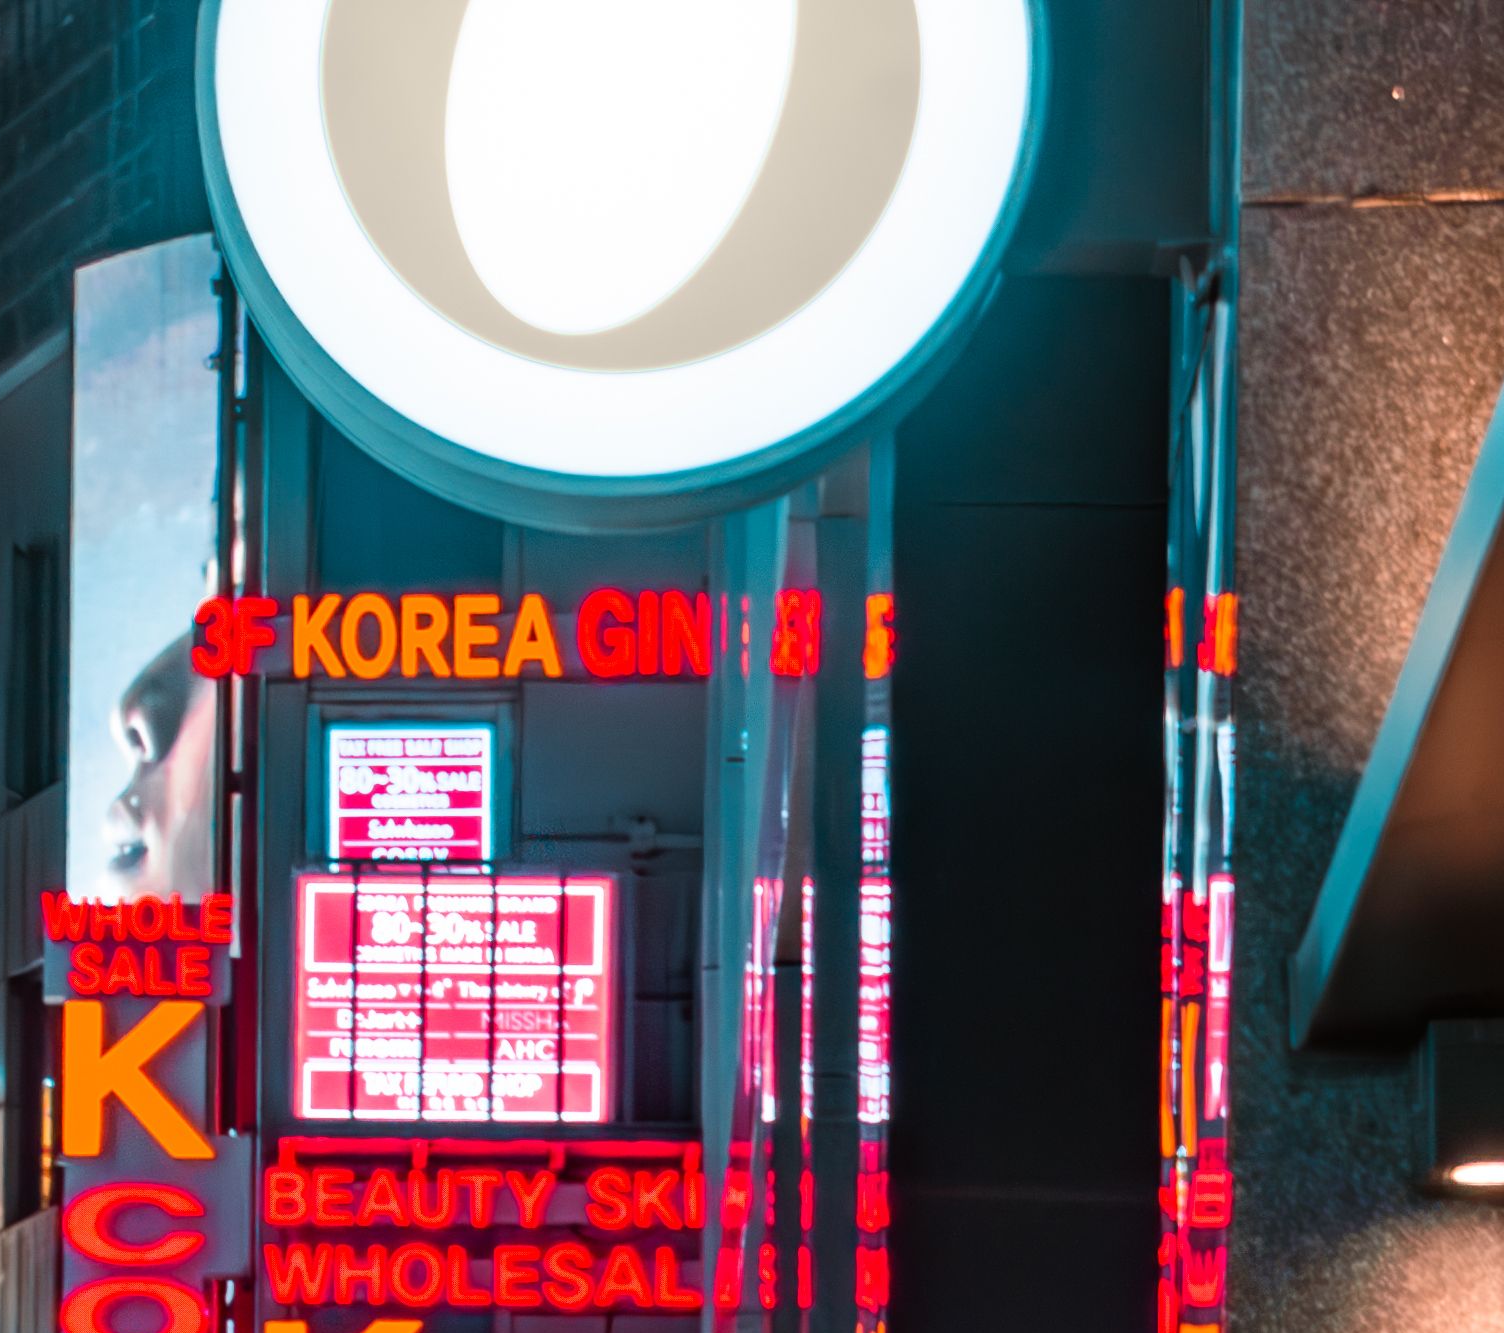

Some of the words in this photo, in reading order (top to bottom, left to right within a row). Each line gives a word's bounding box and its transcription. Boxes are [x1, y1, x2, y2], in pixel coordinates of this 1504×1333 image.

[191, 594, 278, 680] 3F
[292, 592, 563, 680] KOREA
[41, 892, 234, 945] WHOLE
[68, 946, 213, 997] SALE
[263, 1166, 557, 1231] BEAUTY
